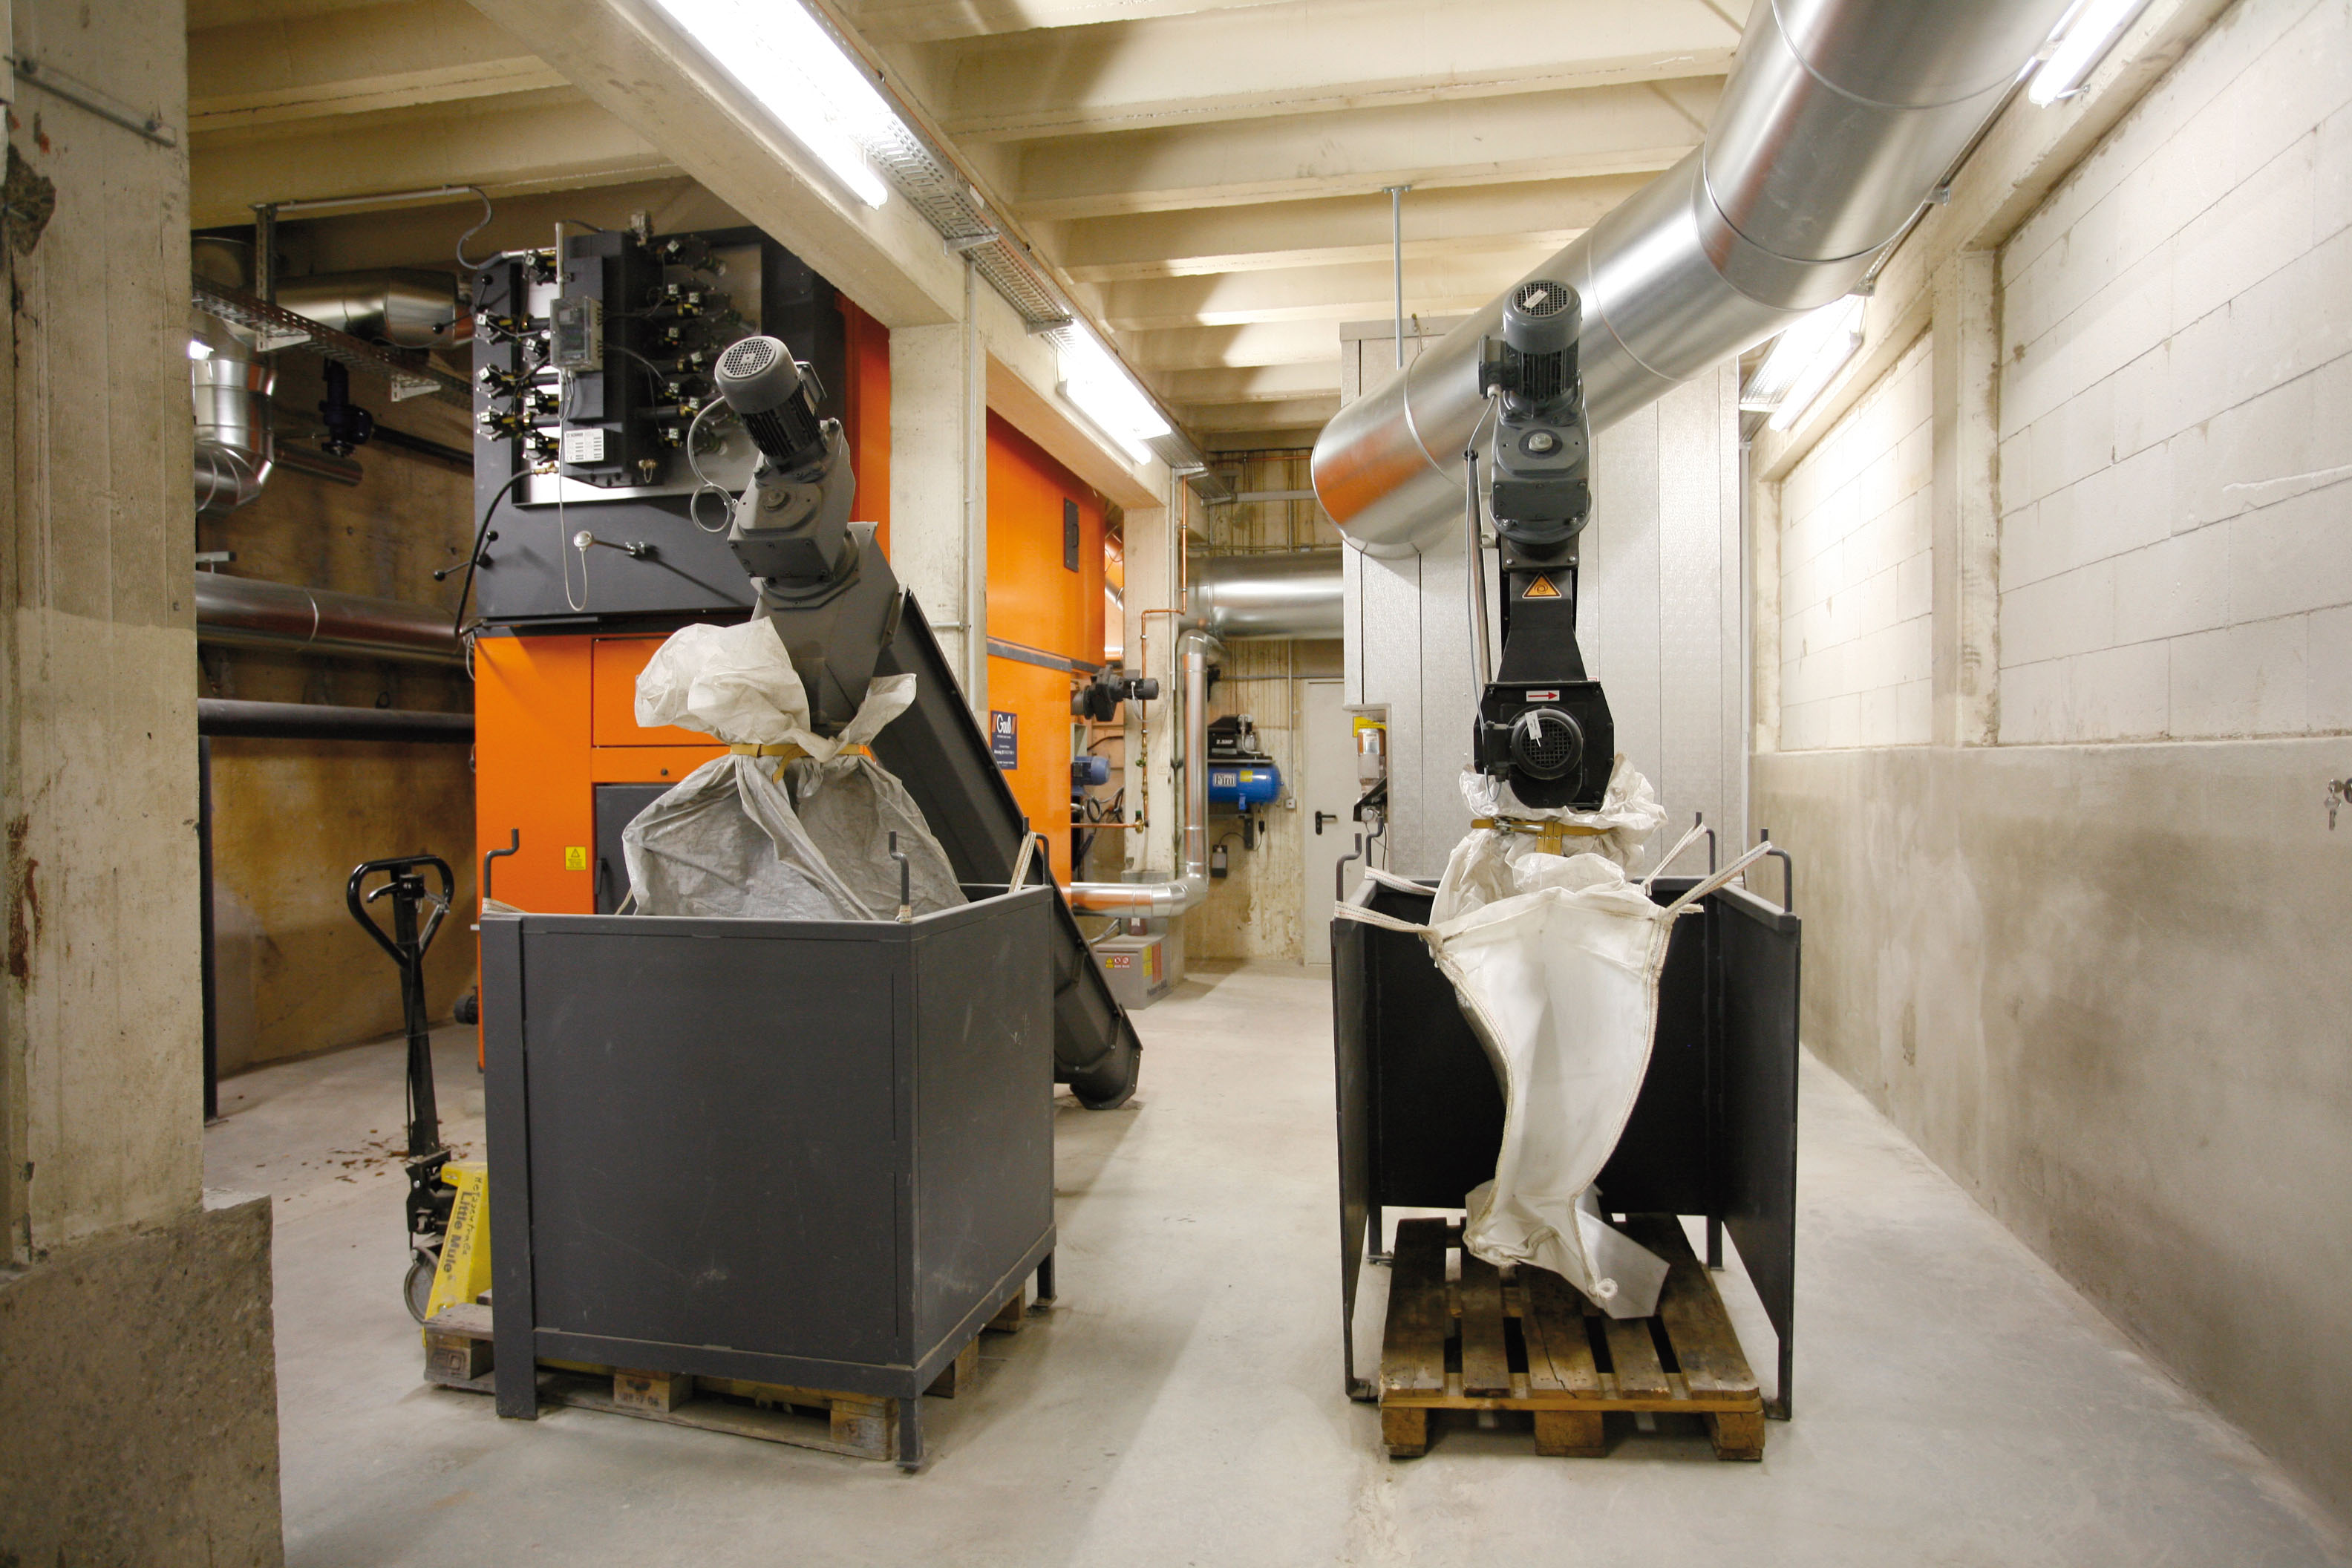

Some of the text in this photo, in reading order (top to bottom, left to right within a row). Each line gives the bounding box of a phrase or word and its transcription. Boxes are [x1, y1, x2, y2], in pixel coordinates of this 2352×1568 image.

[1215, 774, 1234, 785] Fini
[443, 1191, 472, 1273] Little Mule
